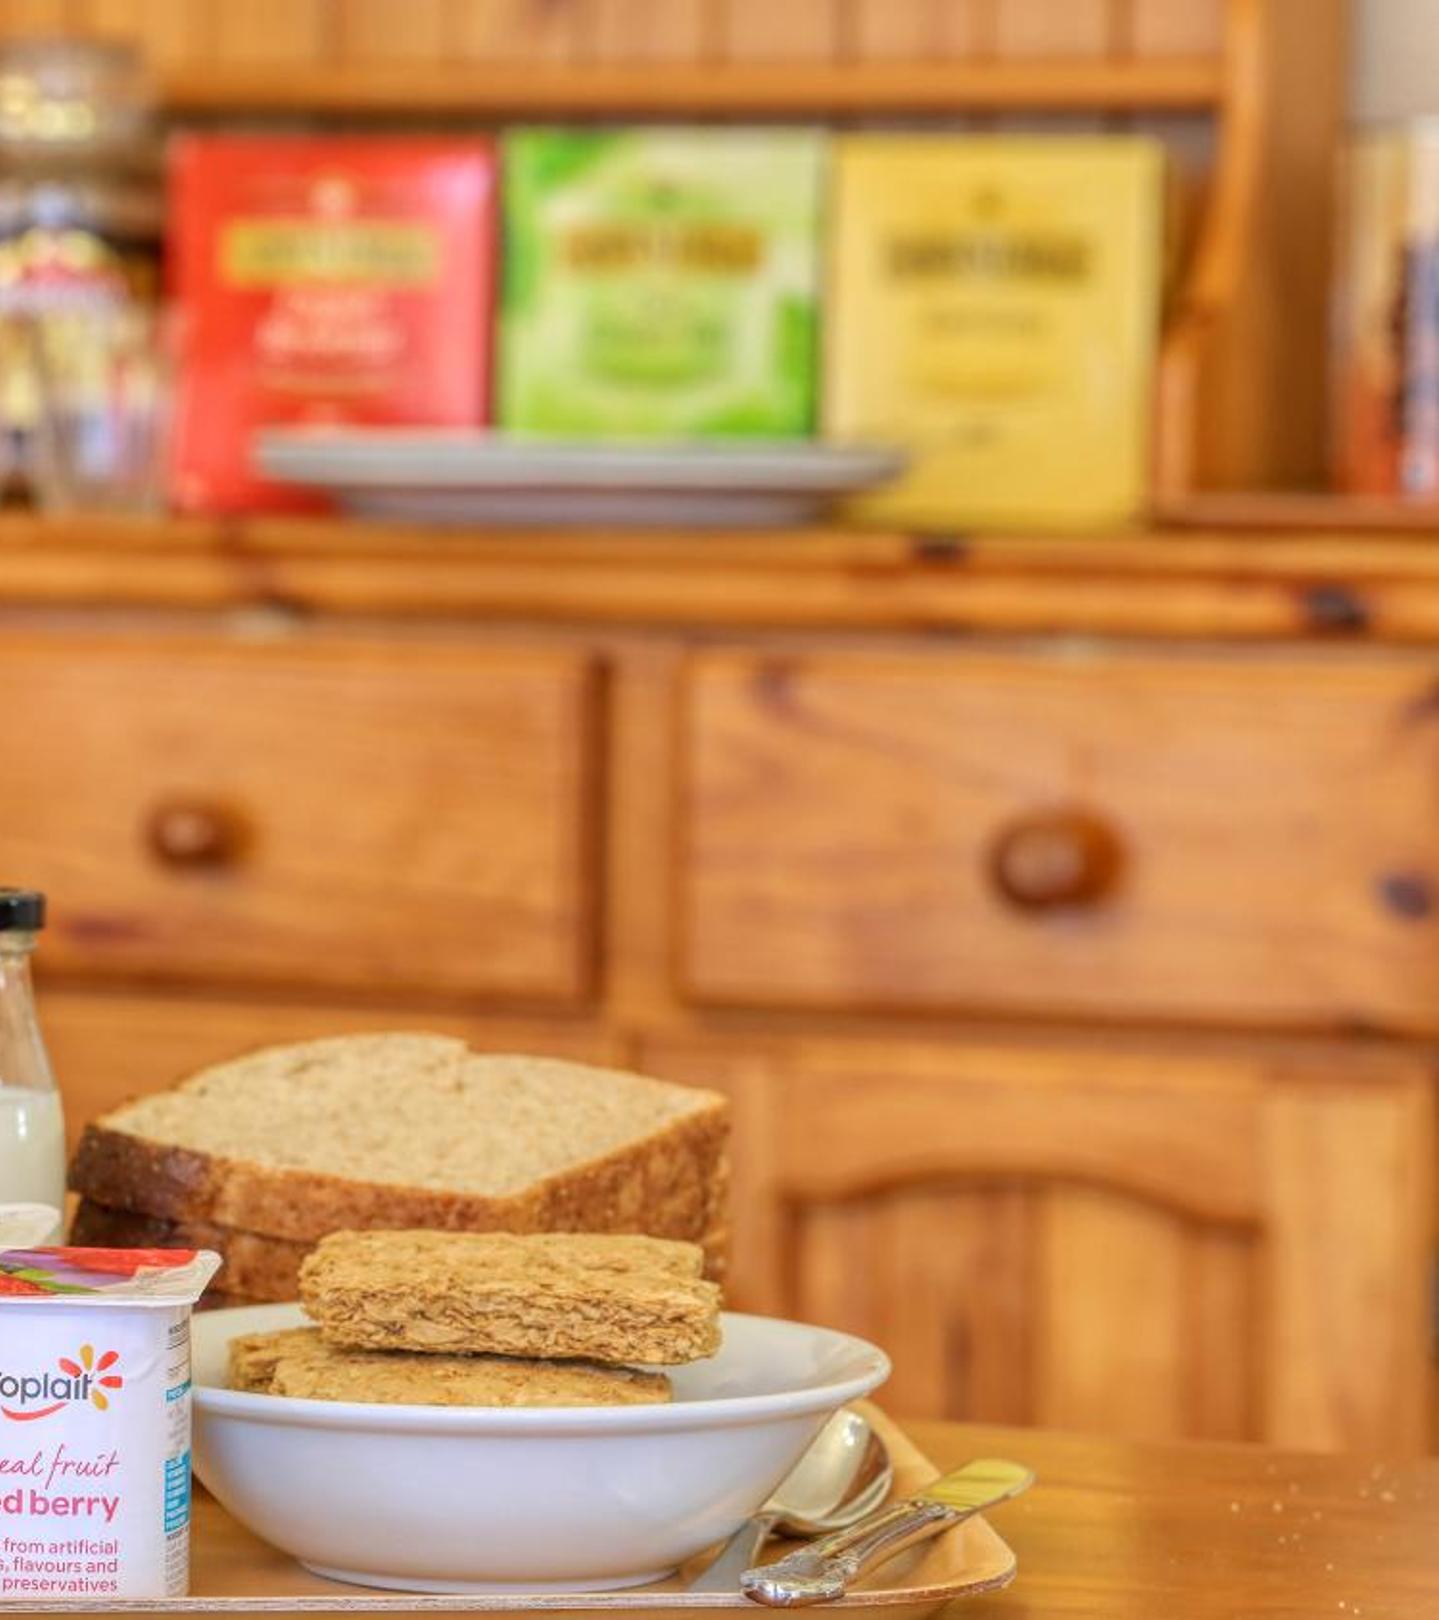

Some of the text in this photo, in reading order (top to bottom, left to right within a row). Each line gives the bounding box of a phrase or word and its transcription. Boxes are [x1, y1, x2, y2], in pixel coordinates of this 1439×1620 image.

[44, 1443, 121, 1490] fruit
[29, 1488, 120, 1523] berry
[4, 1536, 45, 1554] from
[48, 1538, 119, 1556] artificial
[13, 1556, 82, 1574] flavours
[85, 1558, 118, 1574] and
[2, 1575, 119, 1593] preservatives
